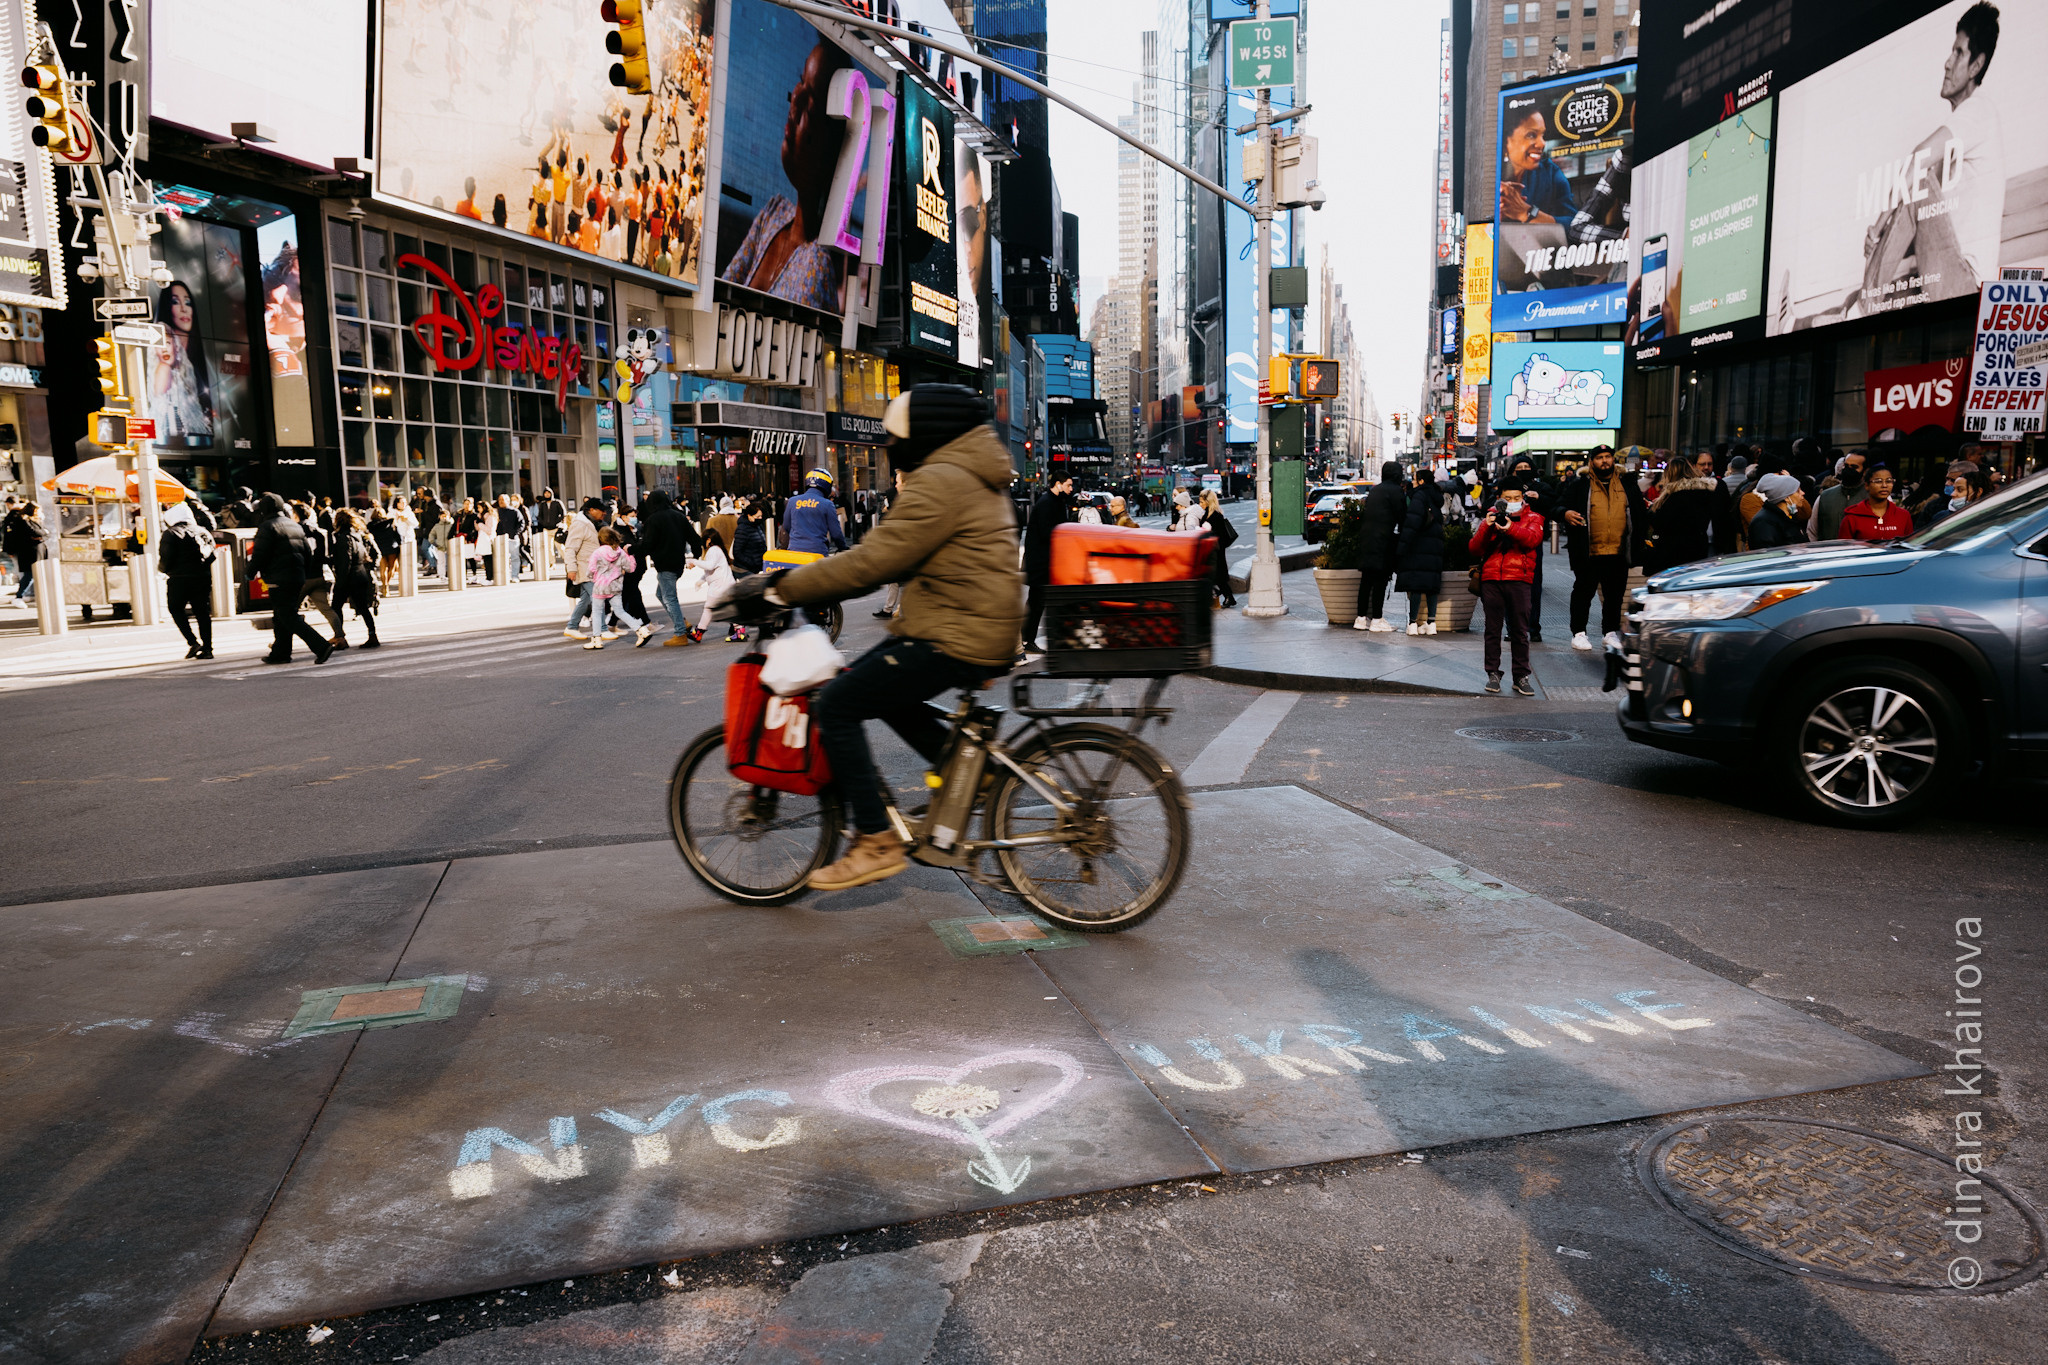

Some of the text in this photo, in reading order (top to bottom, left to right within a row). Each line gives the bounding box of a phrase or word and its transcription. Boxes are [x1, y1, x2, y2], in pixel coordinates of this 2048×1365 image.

[1255, 28, 1271, 41] TO
[1240, 45, 1287, 61] W 45 St
[1737, 70, 1773, 96] MARRIOTT
[1567, 95, 1609, 113] CRITICS
[1737, 85, 1768, 109] MARQUIS
[1567, 105, 1609, 122] CHOICE
[1567, 115, 1609, 128] AWARDS
[1550, 139, 1624, 158] BEST DRAMA SERIES
[817, 69, 897, 266] 21
[1856, 138, 1965, 220] MIKE D
[916, 183, 949, 224] REFLEX
[1690, 194, 1759, 231] SCAN YOUR WATCH
[1917, 196, 1960, 221] MUSICIAN
[917, 208, 950, 244] FINANCE
[1692, 215, 1754, 248] FOR A SURPRISE!
[0, 256, 41, 276] ADWAY
[1475, 257, 1484, 266] GET
[1524, 246, 1555, 274] THE
[1554, 242, 1597, 270] GOOD
[1469, 267, 1490, 277] TICKETS
[2003, 269, 2043, 281] WORD OF GOD
[1049, 273, 1058, 312] 1500
[1469, 278, 1489, 293] HERE
[1867, 286, 1881, 298] was
[1883, 283, 1895, 294] like
[1896, 280, 1908, 291] the
[1909, 276, 1923, 288] first
[1924, 272, 1941, 284] time
[1988, 285, 2048, 303] ONLY
[103, 304, 143, 314] ONE WAY
[1469, 294, 1489, 305] TODAY
[1689, 298, 1714, 315] swatch
[1872, 297, 1892, 311] heard
[1892, 298, 1905, 310] rap
[1523, 300, 1600, 322] Paramount+
[1982, 304, 2048, 331] JESUS
[714, 302, 826, 389] FOREVER
[1691, 331, 1734, 347] #SwatchPeanuts
[1637, 346, 1658, 360] swatch
[1975, 371, 2041, 387] SAVES
[1968, 390, 2045, 410] REPENT
[841, 416, 852, 431] U.S.
[853, 418, 870, 432] POLO
[1966, 416, 2040, 432] END IS NEAR
[749, 429, 807, 456] FOREVER 21
[796, 499, 820, 509] getir
[1129, 990, 1715, 1093] UKRAINE
[448, 1090, 801, 1200] NYC
